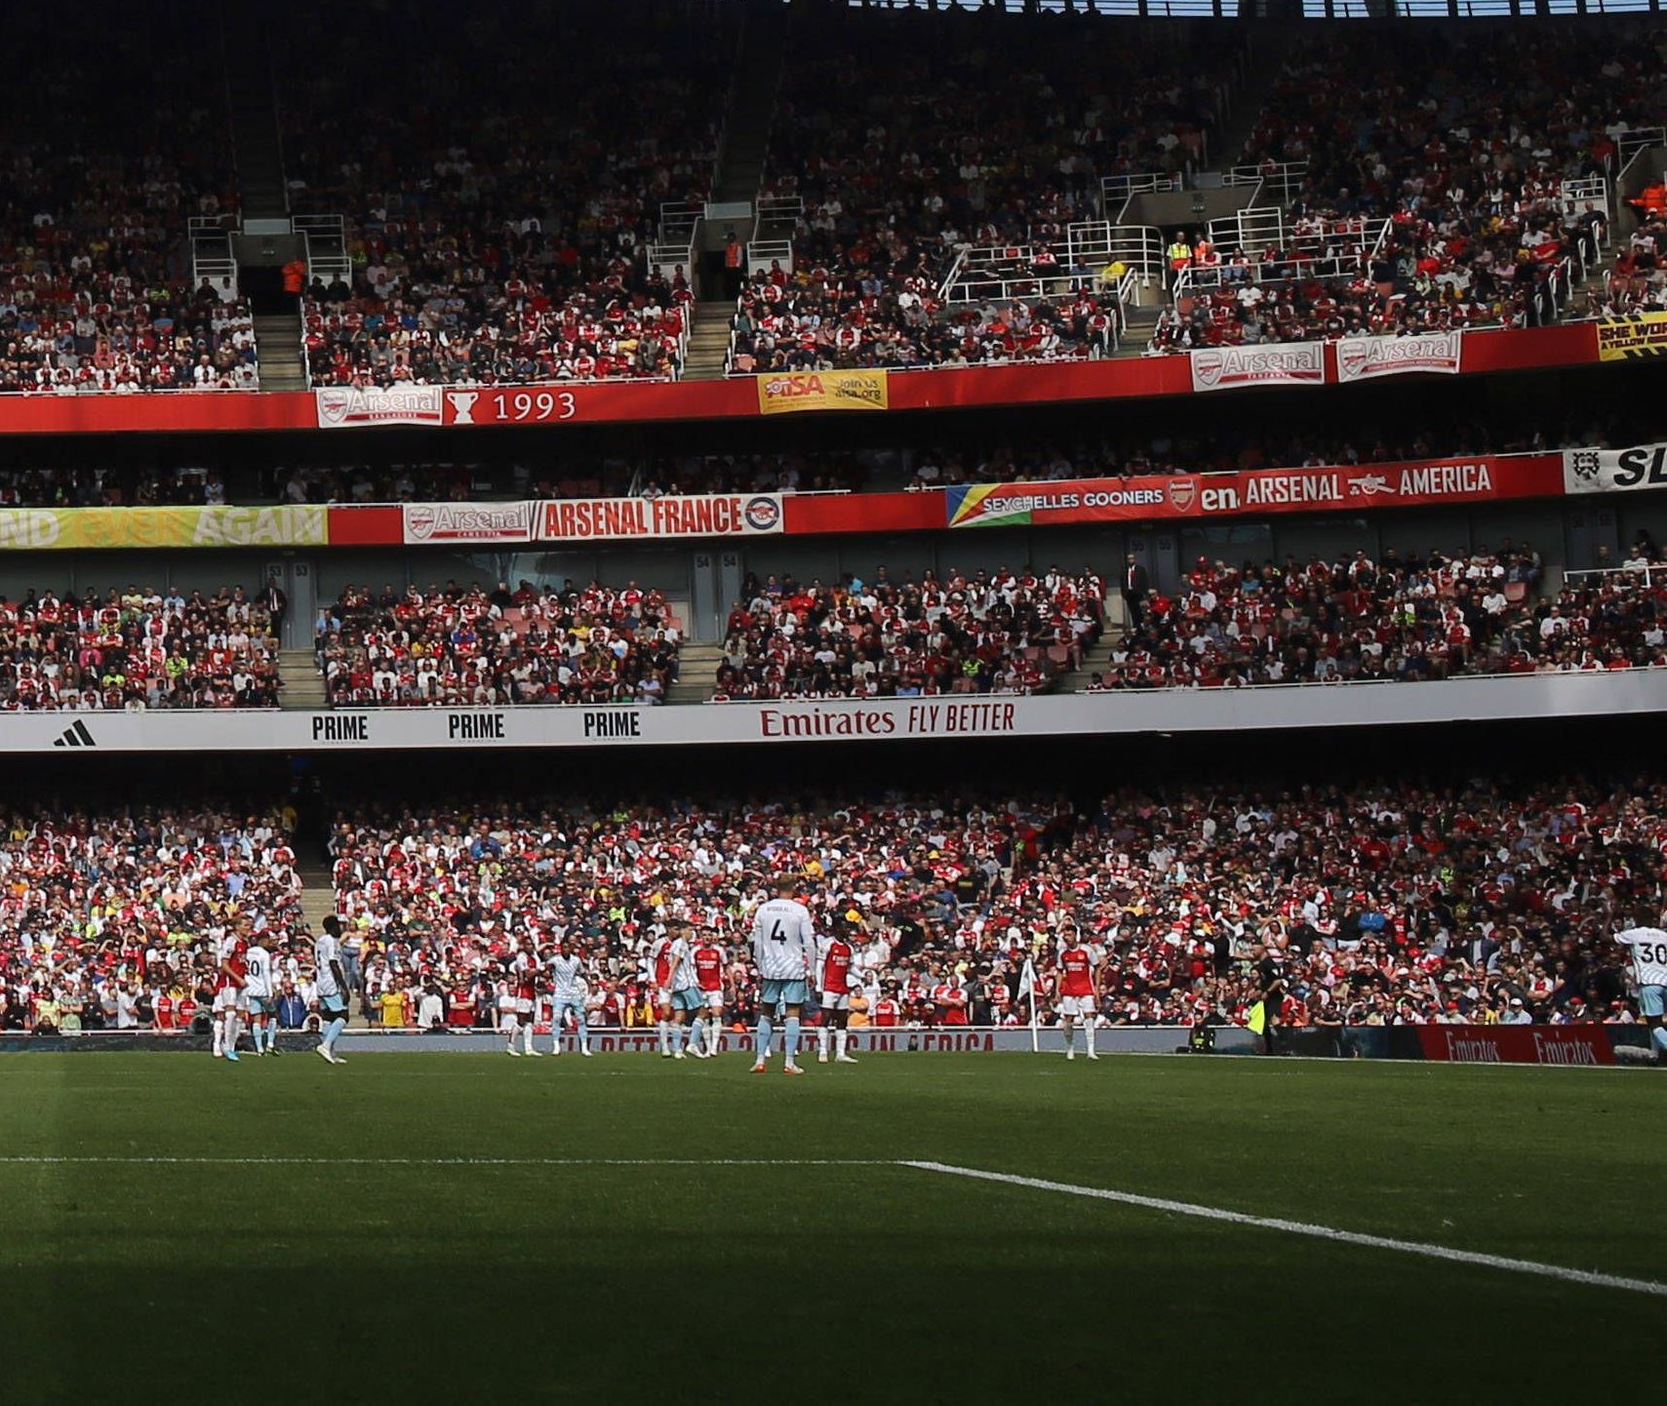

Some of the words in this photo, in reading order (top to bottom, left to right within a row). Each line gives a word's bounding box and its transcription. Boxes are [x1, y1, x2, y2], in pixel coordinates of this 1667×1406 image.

[1600, 326, 1631, 341] SHE
[1609, 338, 1645, 349] YELLOW
[1224, 345, 1322, 373] Arsenal
[1369, 334, 1458, 361] Arsenal
[349, 390, 441, 412] Arsenal
[493, 392, 576, 420] 1993
[1246, 474, 1344, 505] ARSENAL
[1399, 464, 1492, 496] AMERICA
[982, 493, 1080, 512] SEYCHELLES
[1083, 489, 1165, 507] GOONERS
[192, 507, 327, 545] AGAIN
[434, 505, 527, 530] Arsenal
[544, 502, 649, 537] ARSENAL
[652, 497, 743, 535] FRANCE
[269, 565, 282, 577] 53
[296, 565, 308, 577] 53
[696, 556, 710, 568] 54
[723, 556, 736, 568] 54
[312, 715, 369, 741] PRIME
[448, 713, 506, 739] PRIME
[583, 711, 641, 737] PRIME
[760, 707, 896, 737] Emirates
[908, 705, 942, 733] FLY
[946, 702, 1015, 732] BETTER
[771, 919, 787, 946] 4
[1639, 943, 1667, 966] 30
